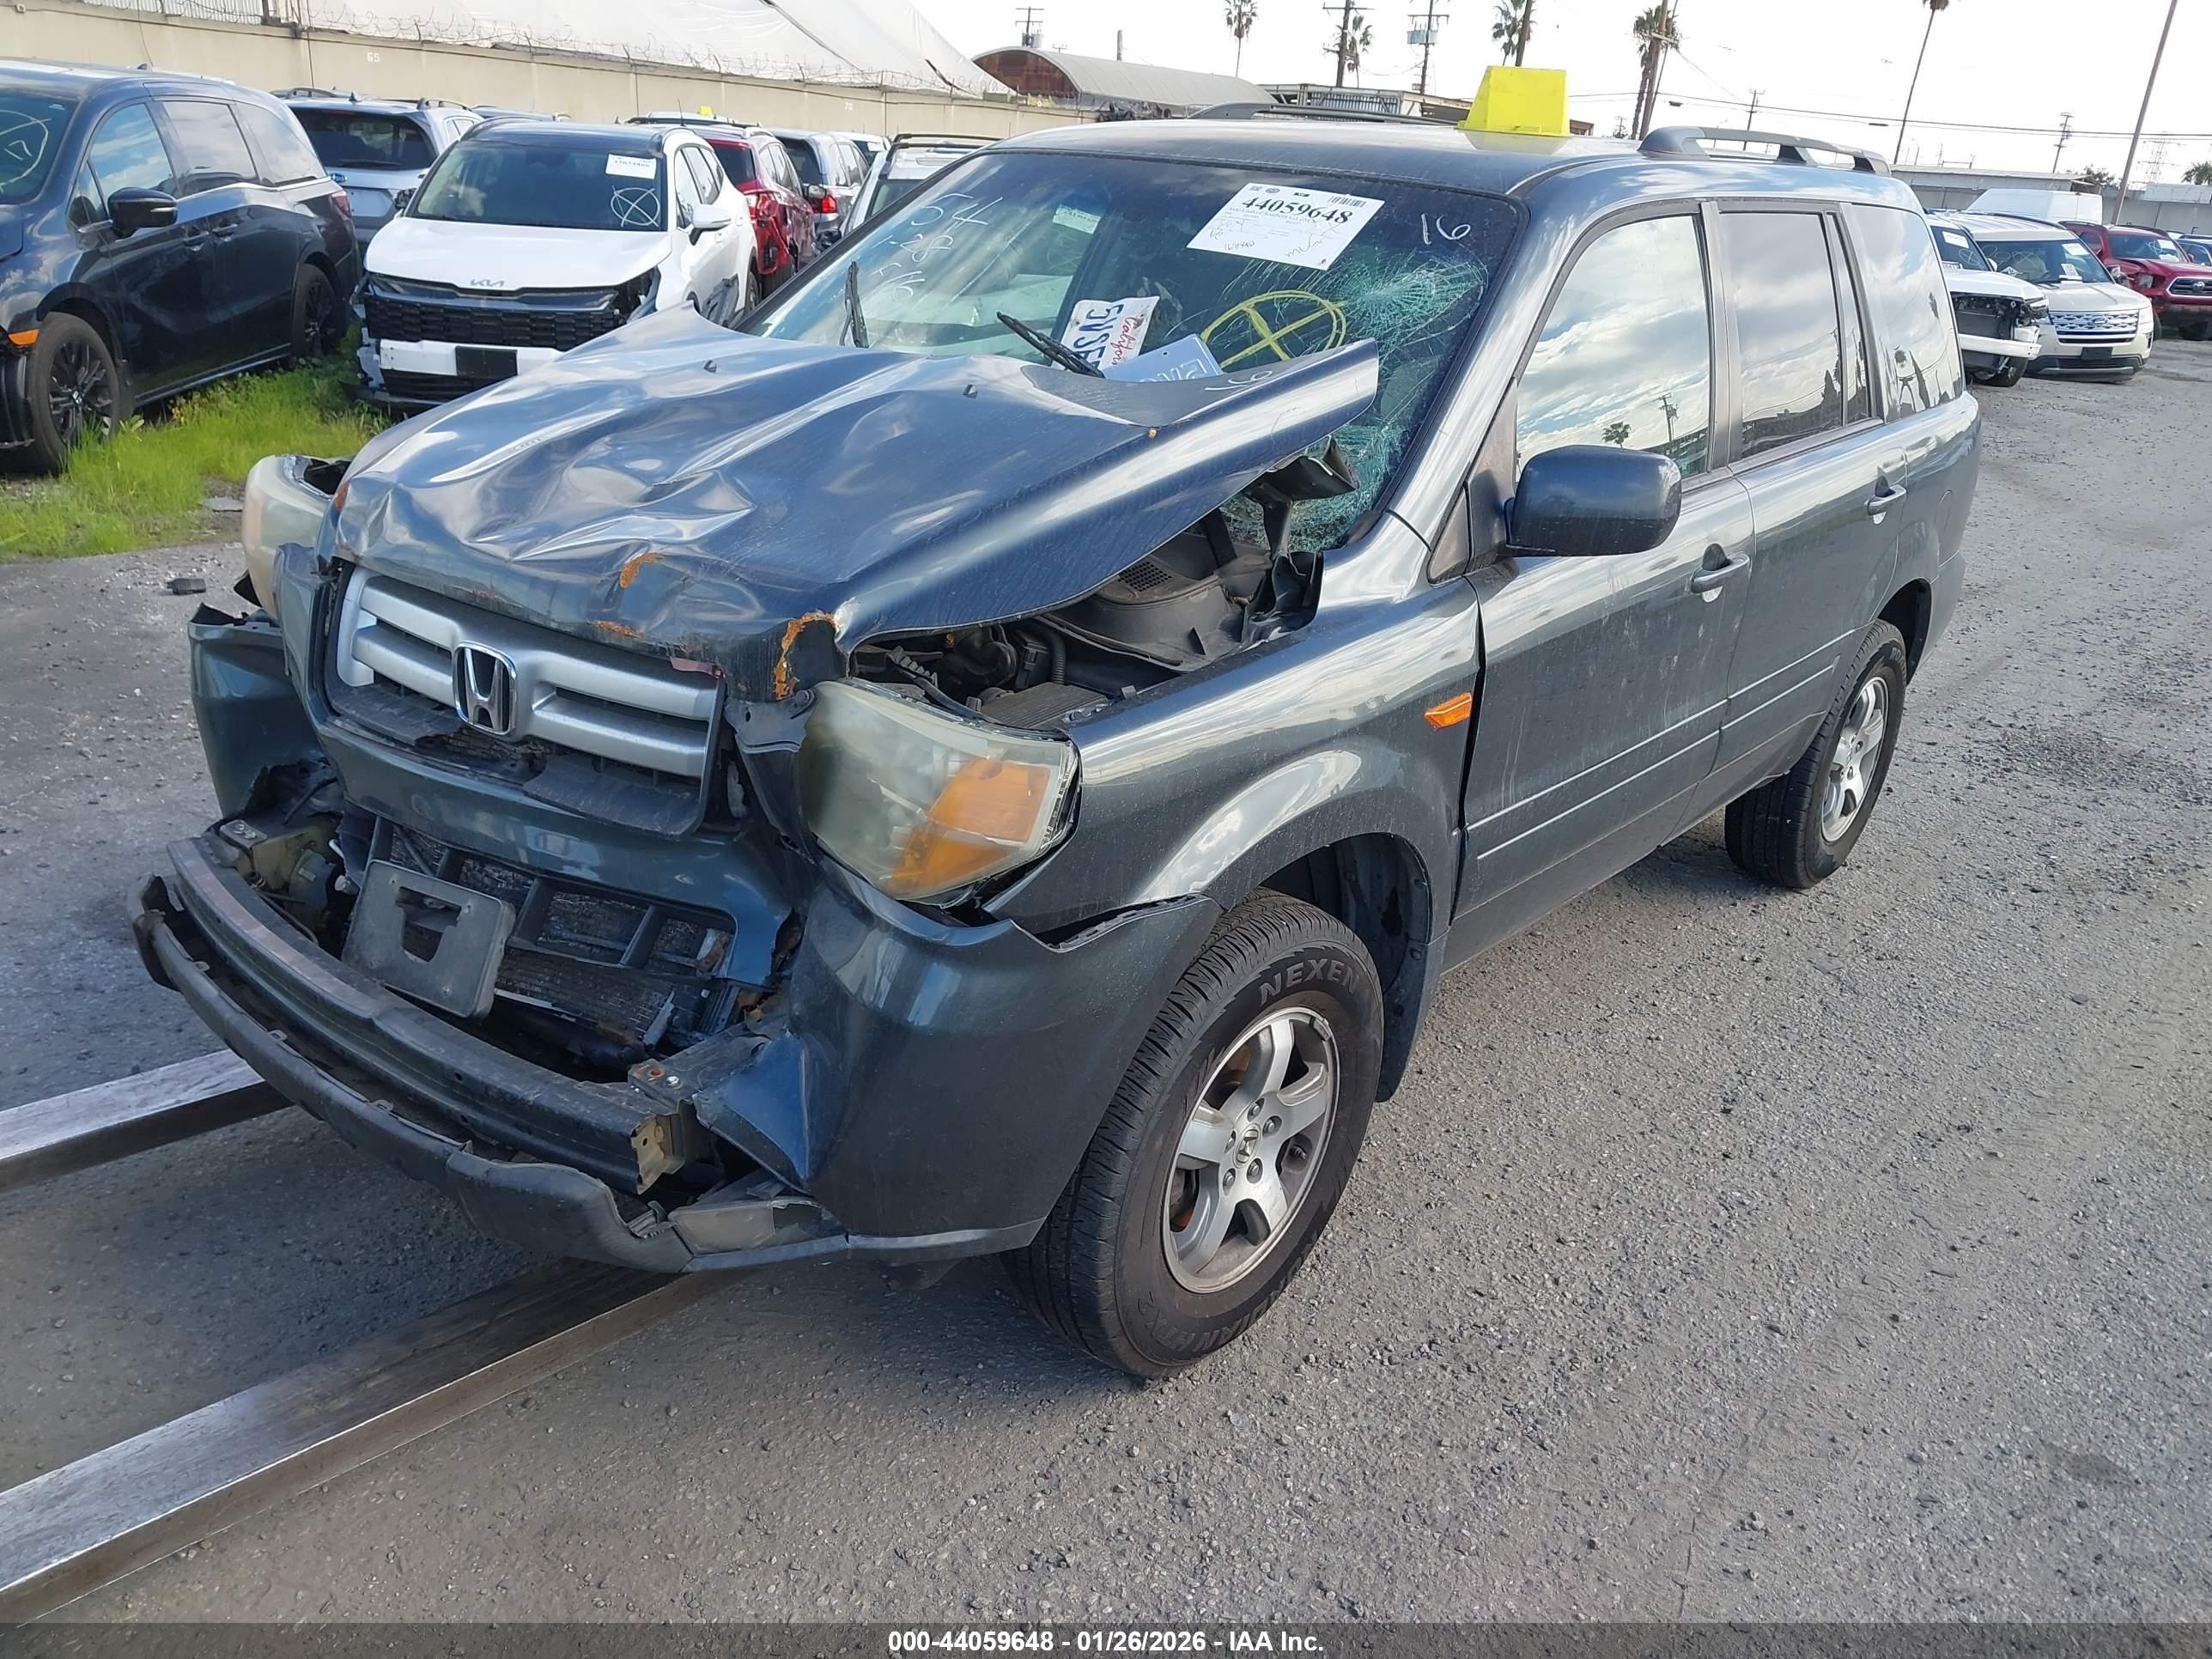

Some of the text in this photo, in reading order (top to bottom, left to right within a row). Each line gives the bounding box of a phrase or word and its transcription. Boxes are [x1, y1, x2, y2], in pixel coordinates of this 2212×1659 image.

[1242, 197, 1353, 224] 44059648
[1420, 212, 1472, 246] 16
[1259, 958, 1360, 1006] NEXEN
